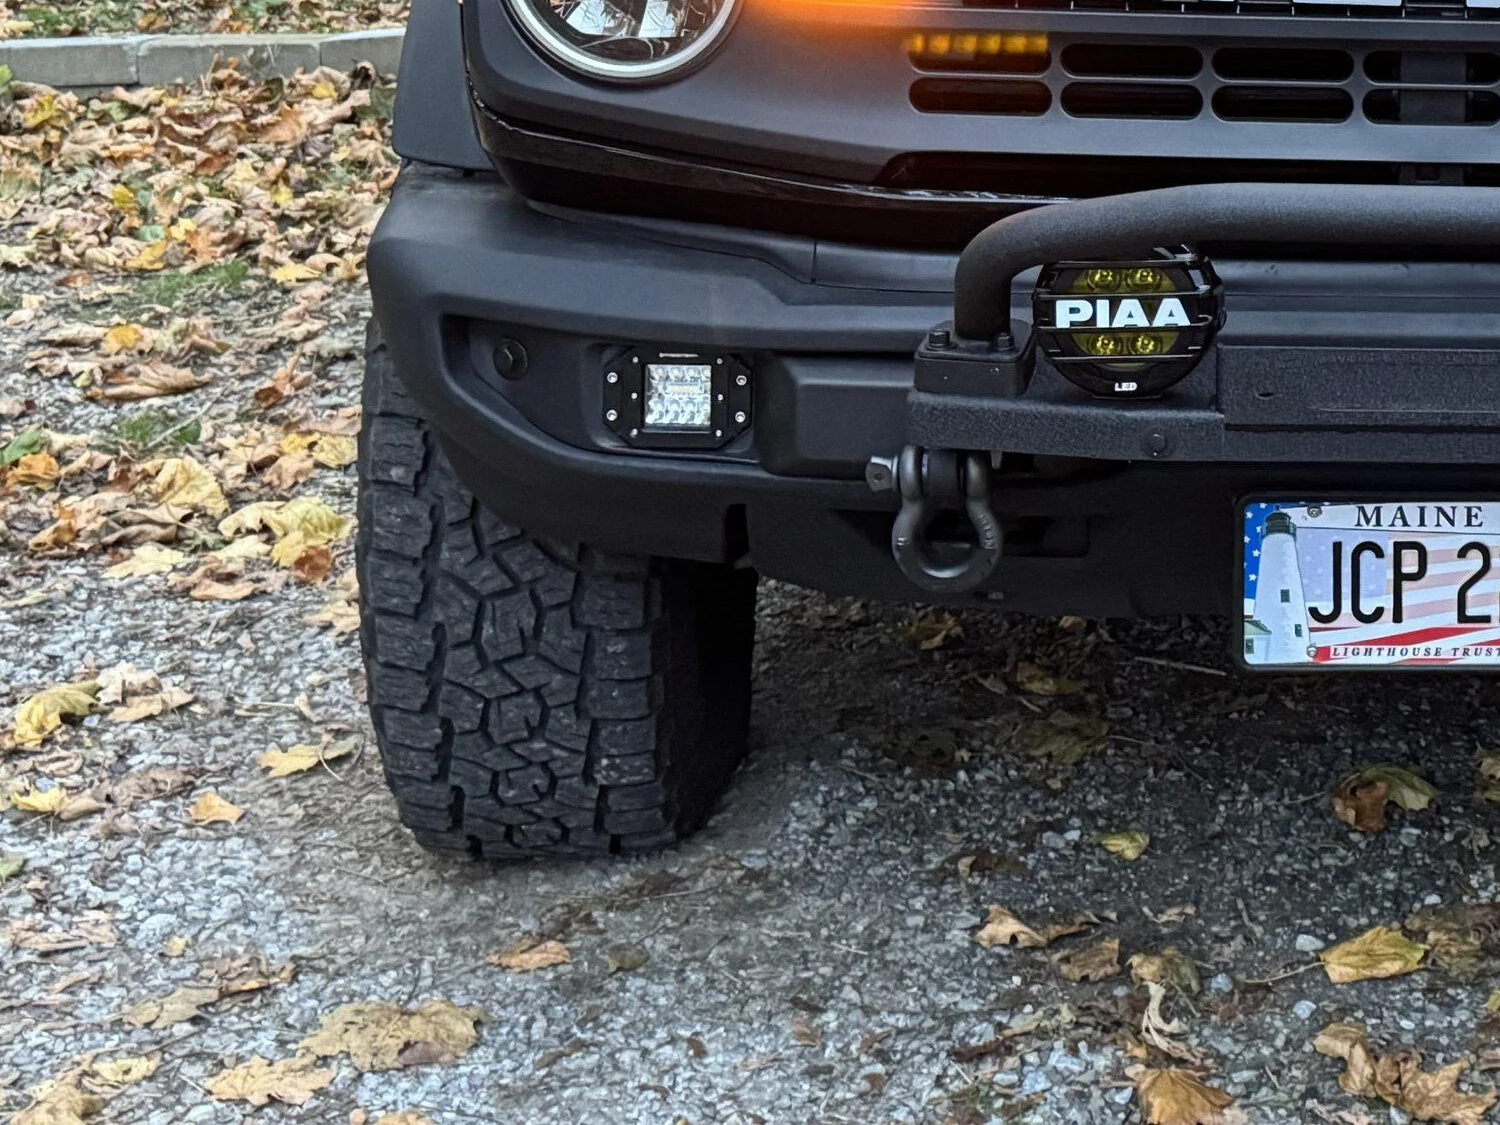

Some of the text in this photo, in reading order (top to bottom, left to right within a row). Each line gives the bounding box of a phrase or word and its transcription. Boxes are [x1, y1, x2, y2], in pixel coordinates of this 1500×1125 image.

[1055, 297, 1191, 329] PIAA
[1354, 505, 1484, 528] MAINE
[1307, 541, 1428, 624] JCP
[1331, 646, 1443, 658] LIGHTHOUSE
